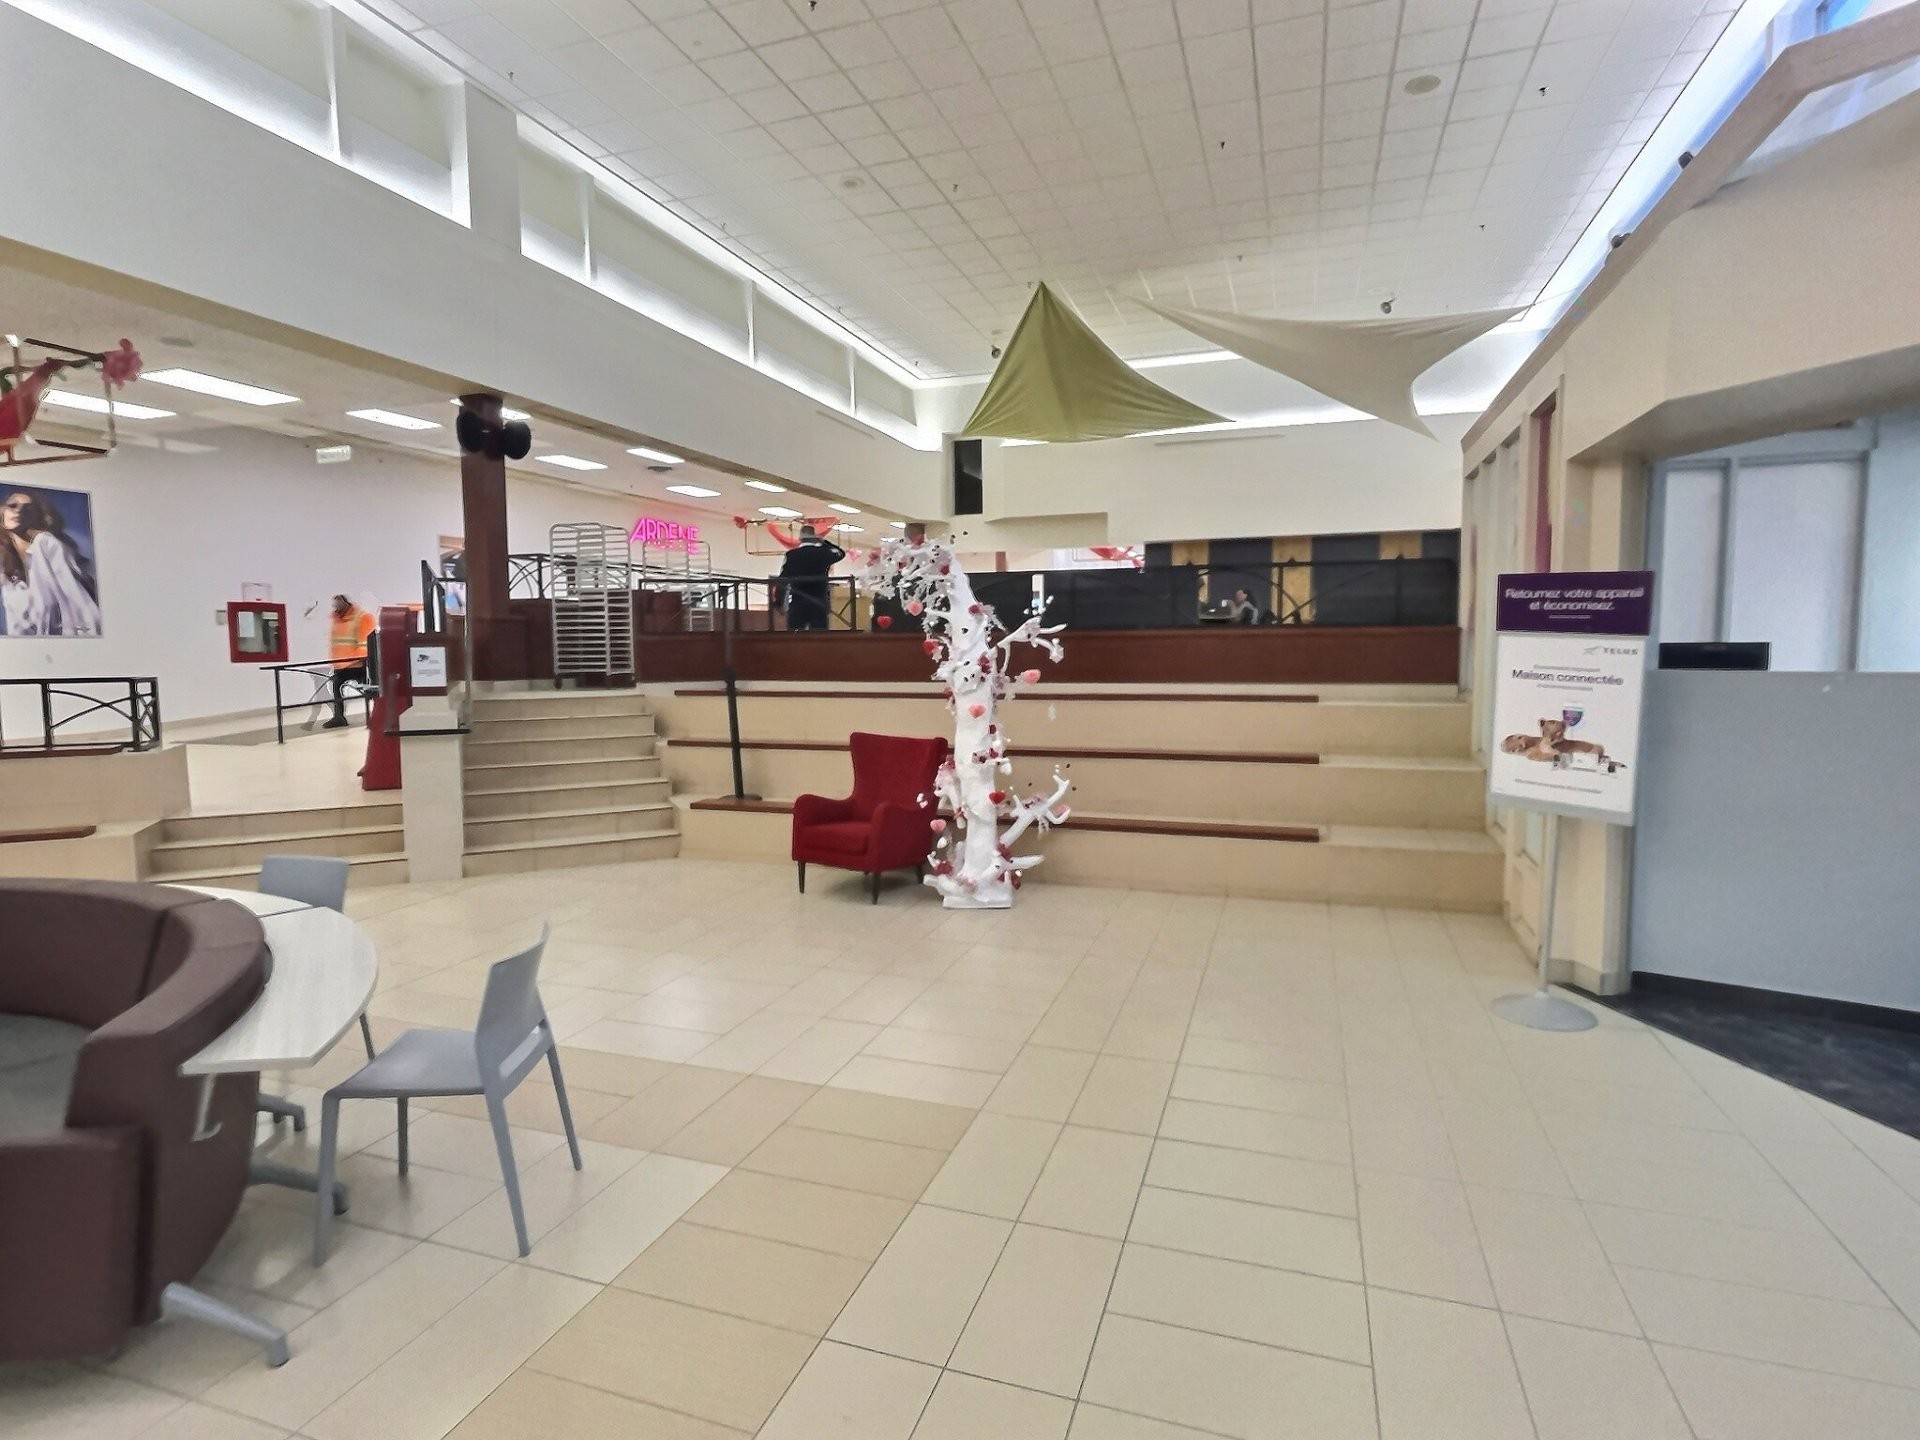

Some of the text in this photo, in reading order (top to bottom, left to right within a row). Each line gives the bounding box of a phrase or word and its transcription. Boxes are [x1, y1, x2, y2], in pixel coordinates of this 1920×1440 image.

[629, 518, 699, 553] ARDENE
[1505, 587, 1644, 600] Retournez votre appareil
[1529, 601, 1541, 611] et
[1602, 647, 1639, 656] TELUS
[1511, 669, 1624, 686] Maison connectée
